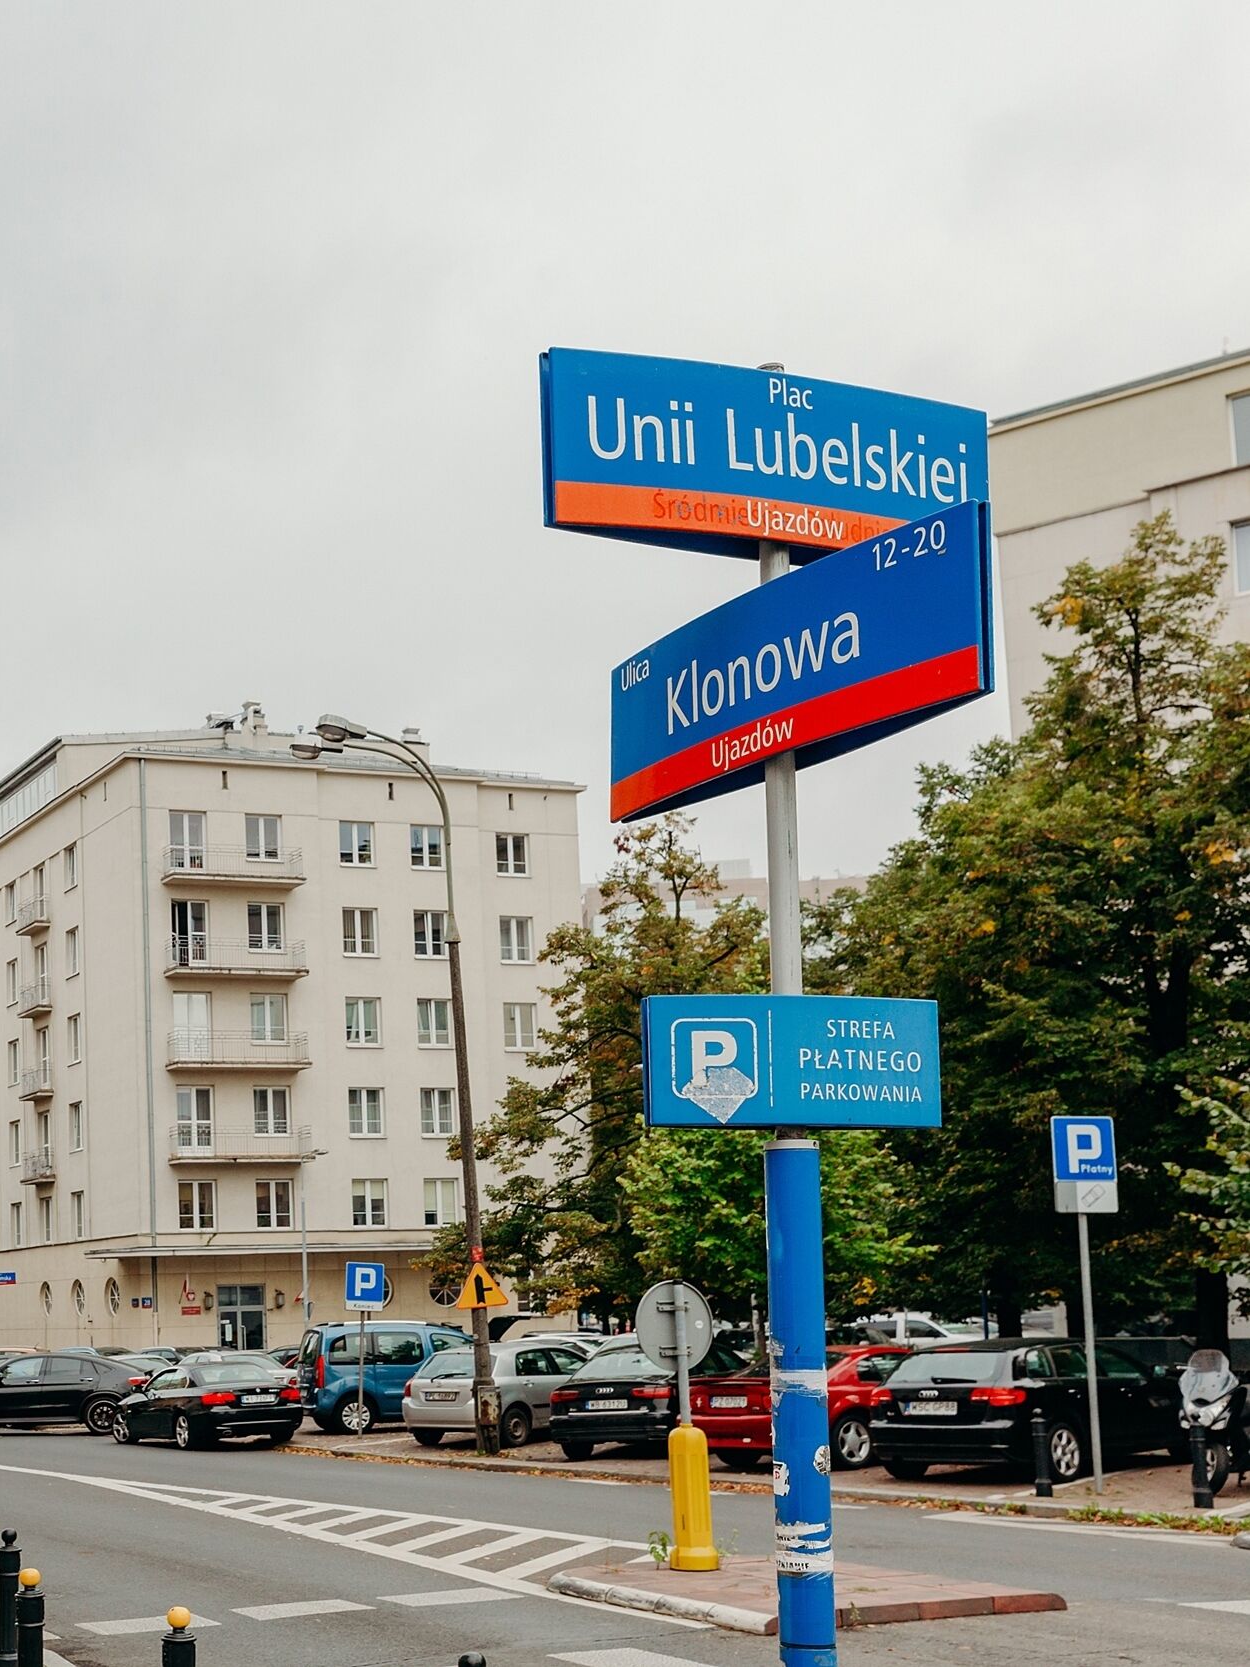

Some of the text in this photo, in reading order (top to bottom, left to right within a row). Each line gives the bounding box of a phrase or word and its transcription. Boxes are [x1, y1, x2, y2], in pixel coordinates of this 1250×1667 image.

[768, 377, 813, 411] Plac
[587, 395, 968, 504] Unii Lubelskiej
[747, 499, 843, 540] Ujazdów
[872, 520, 945, 571] 12-20
[621, 659, 650, 691] Ulica
[667, 611, 860, 735] Klonowa
[711, 718, 794, 770] Ujazdów
[826, 1019, 895, 1040] STREFA
[800, 1048, 922, 1073] PŁATNEGO
[801, 1083, 922, 1103] PARKOWANIA
[1066, 1124, 1102, 1173] P
[1080, 1164, 1113, 1176] Płatny
[355, 1267, 376, 1296] P
[912, 1402, 929, 1411] WSC
